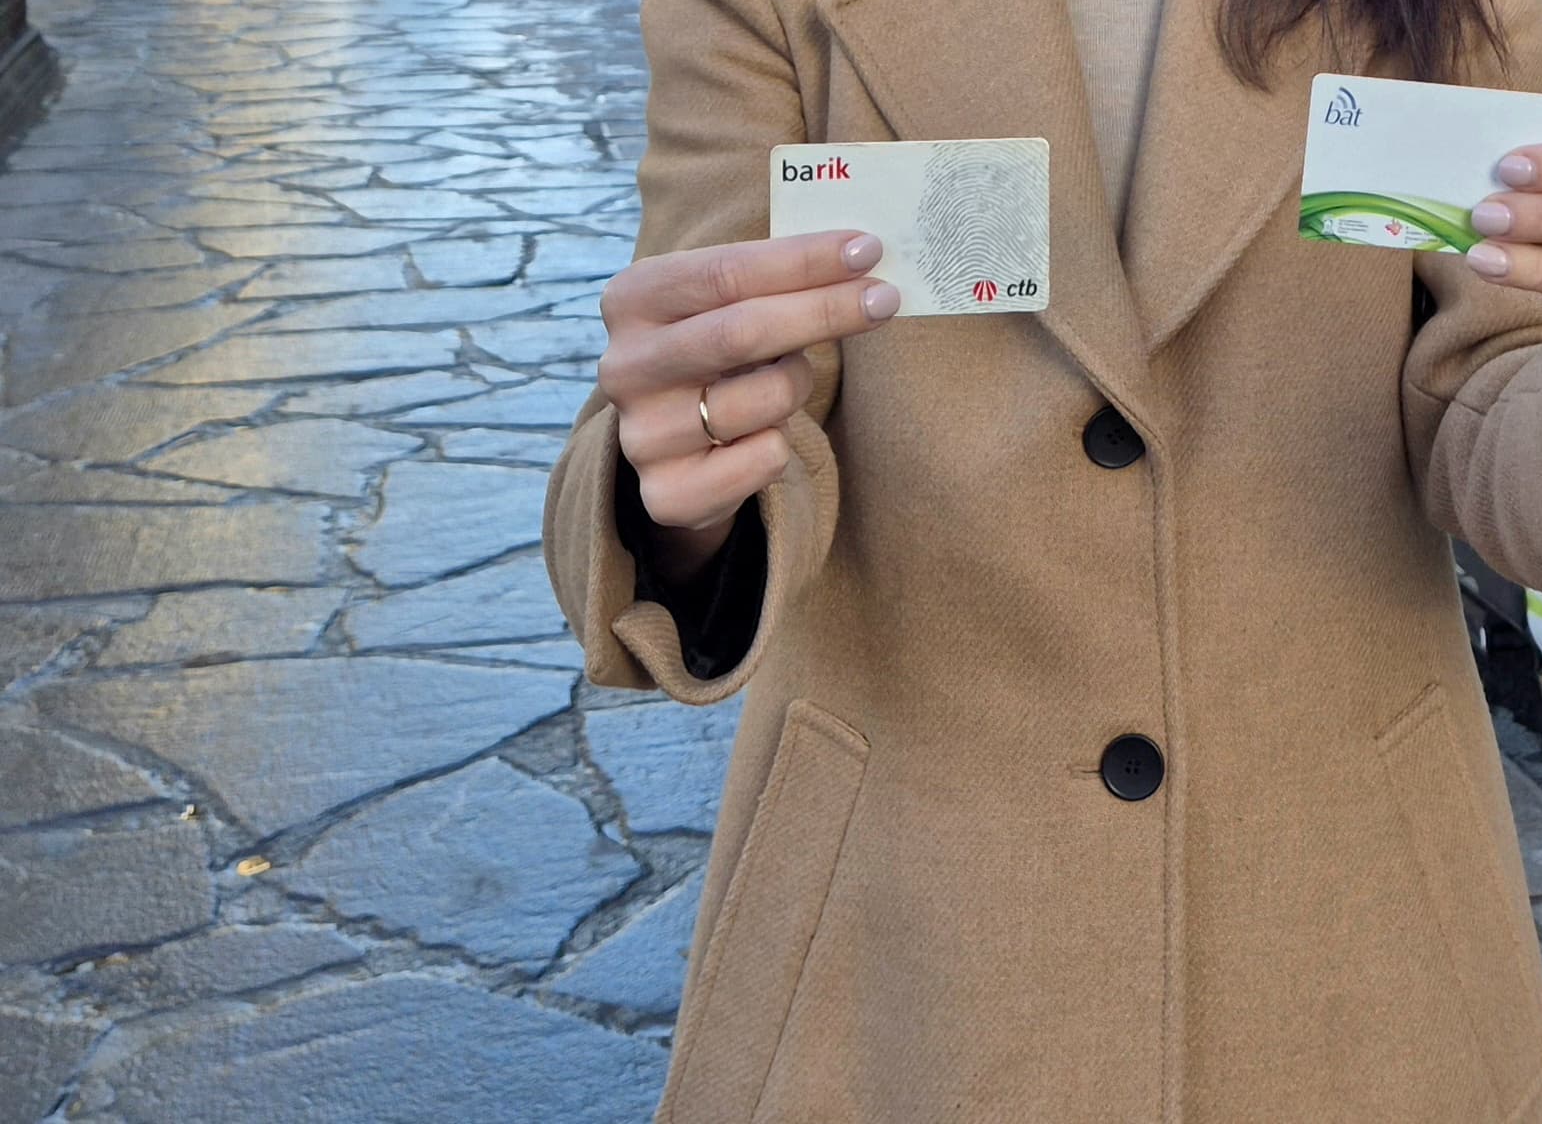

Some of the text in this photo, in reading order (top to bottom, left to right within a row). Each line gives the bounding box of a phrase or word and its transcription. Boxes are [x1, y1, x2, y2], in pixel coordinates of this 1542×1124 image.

[1324, 101, 1363, 127] bat
[782, 157, 850, 181] barik
[1006, 280, 1038, 298] ctb
